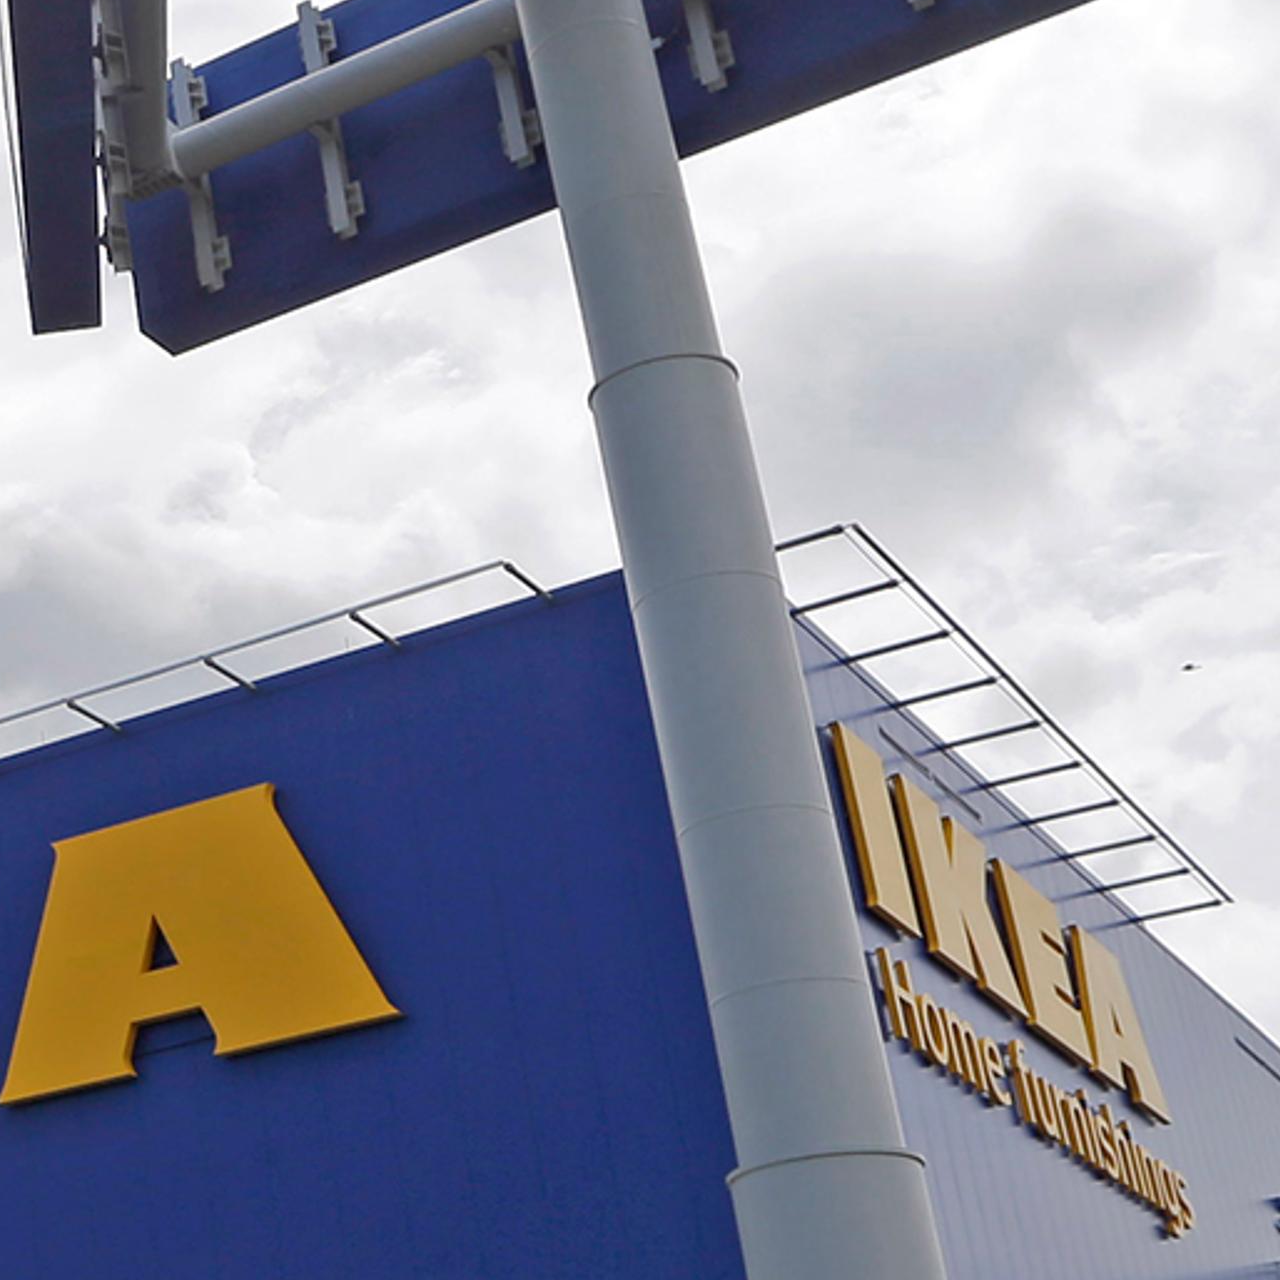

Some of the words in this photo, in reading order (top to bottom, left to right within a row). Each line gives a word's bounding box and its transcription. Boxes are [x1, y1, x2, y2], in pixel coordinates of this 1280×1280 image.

[830, 721, 1171, 1124] IKEA
[877, 947, 1012, 1106] Home
[1006, 1039, 1195, 1237] furnishings
